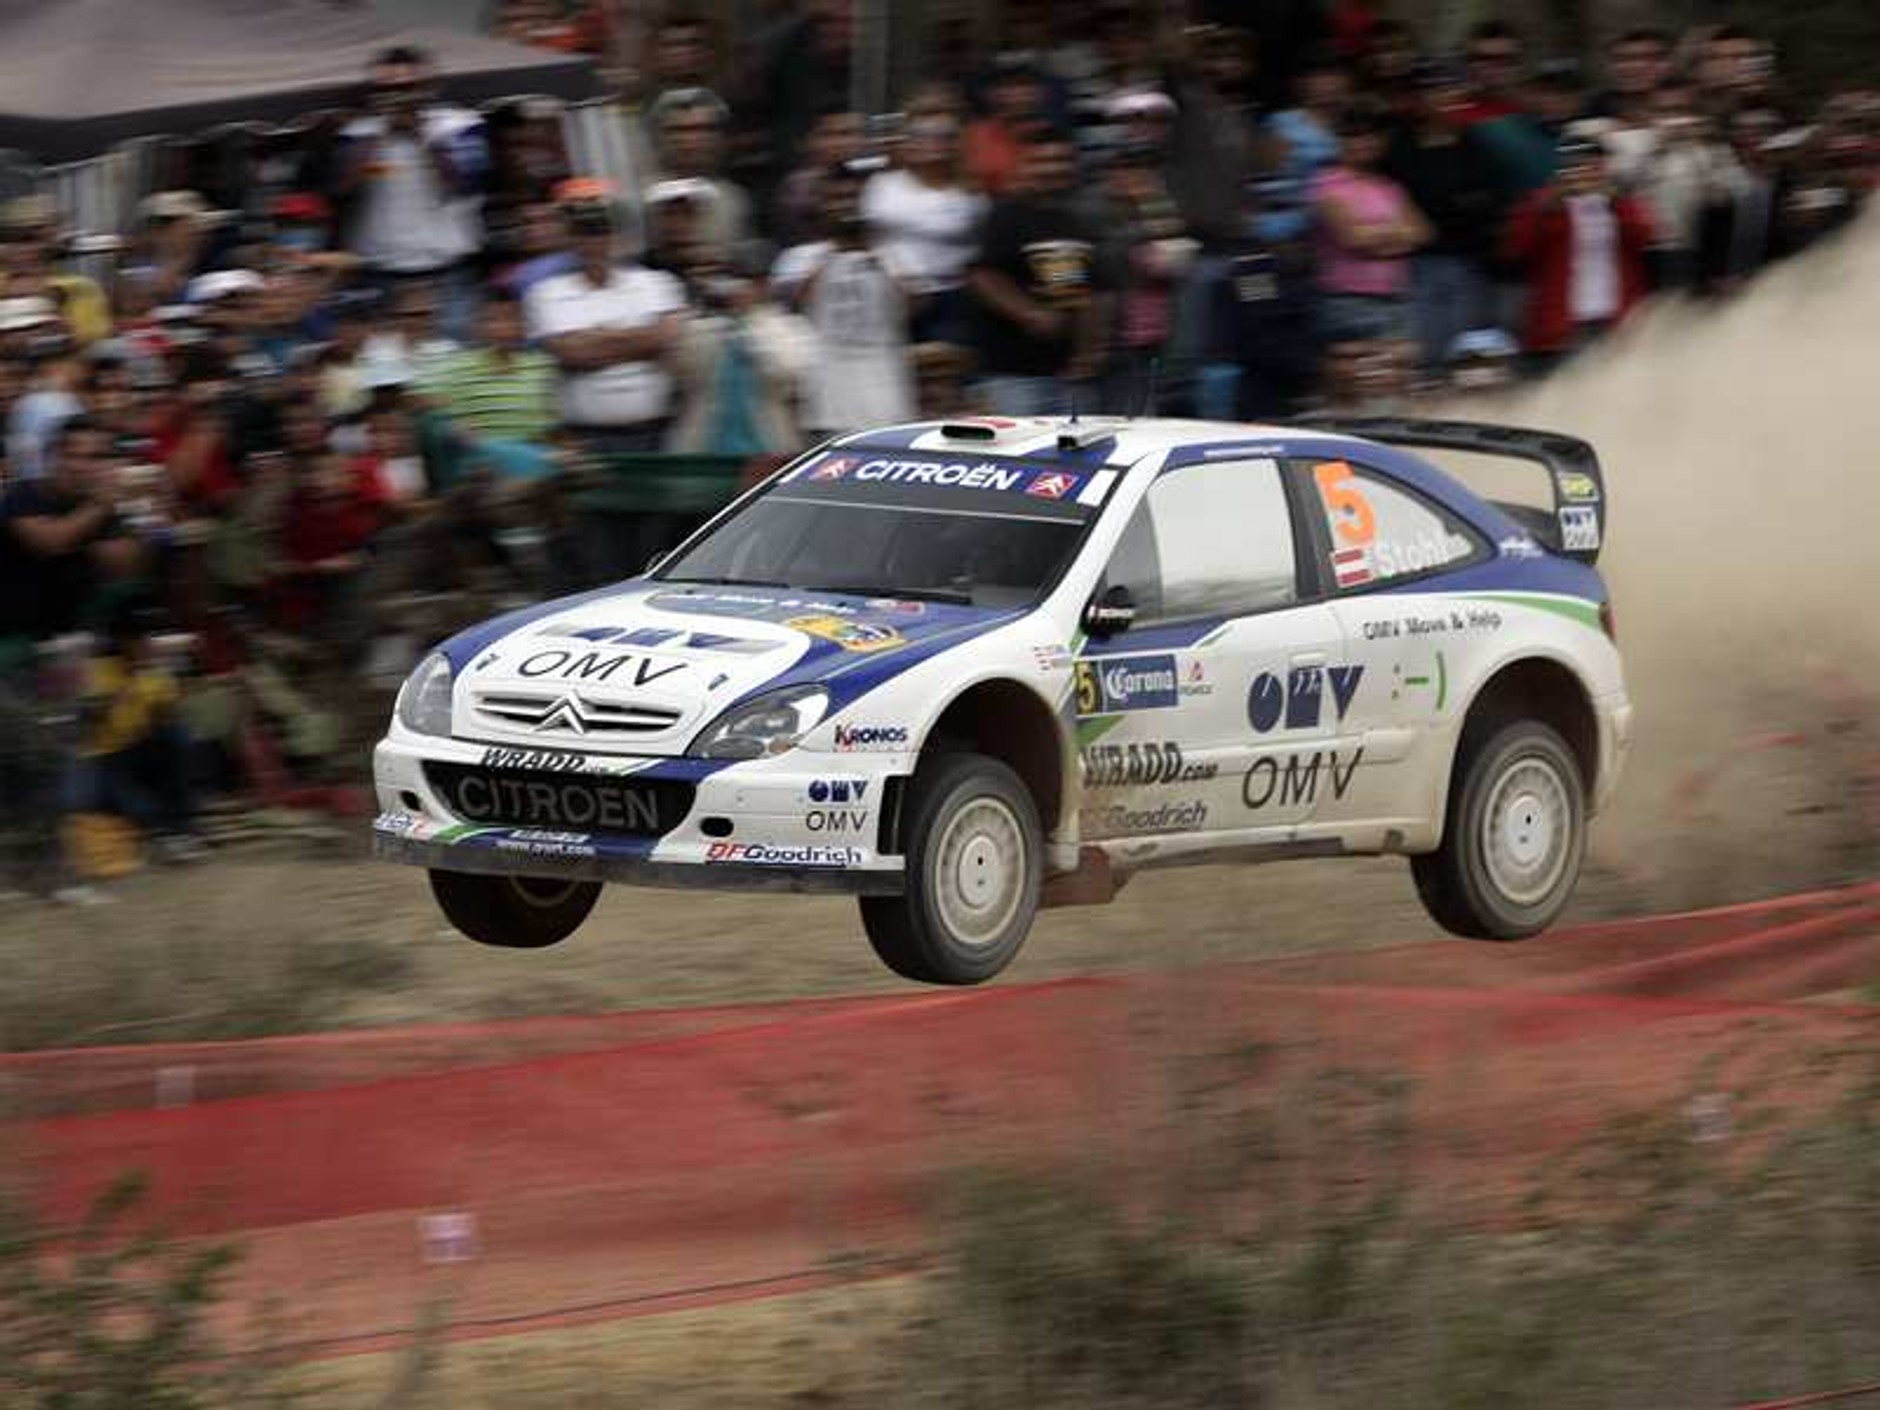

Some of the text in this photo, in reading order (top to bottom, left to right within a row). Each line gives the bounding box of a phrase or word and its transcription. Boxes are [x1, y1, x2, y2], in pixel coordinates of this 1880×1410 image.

[855, 459, 1023, 490] CITROËN
[1312, 459, 1376, 546] 5
[1450, 613, 1464, 629] &
[518, 651, 689, 687] OMV
[1107, 666, 1174, 700] Corona
[1076, 660, 1096, 714] 5
[1241, 746, 1366, 810] OMV
[805, 810, 868, 831] OMV
